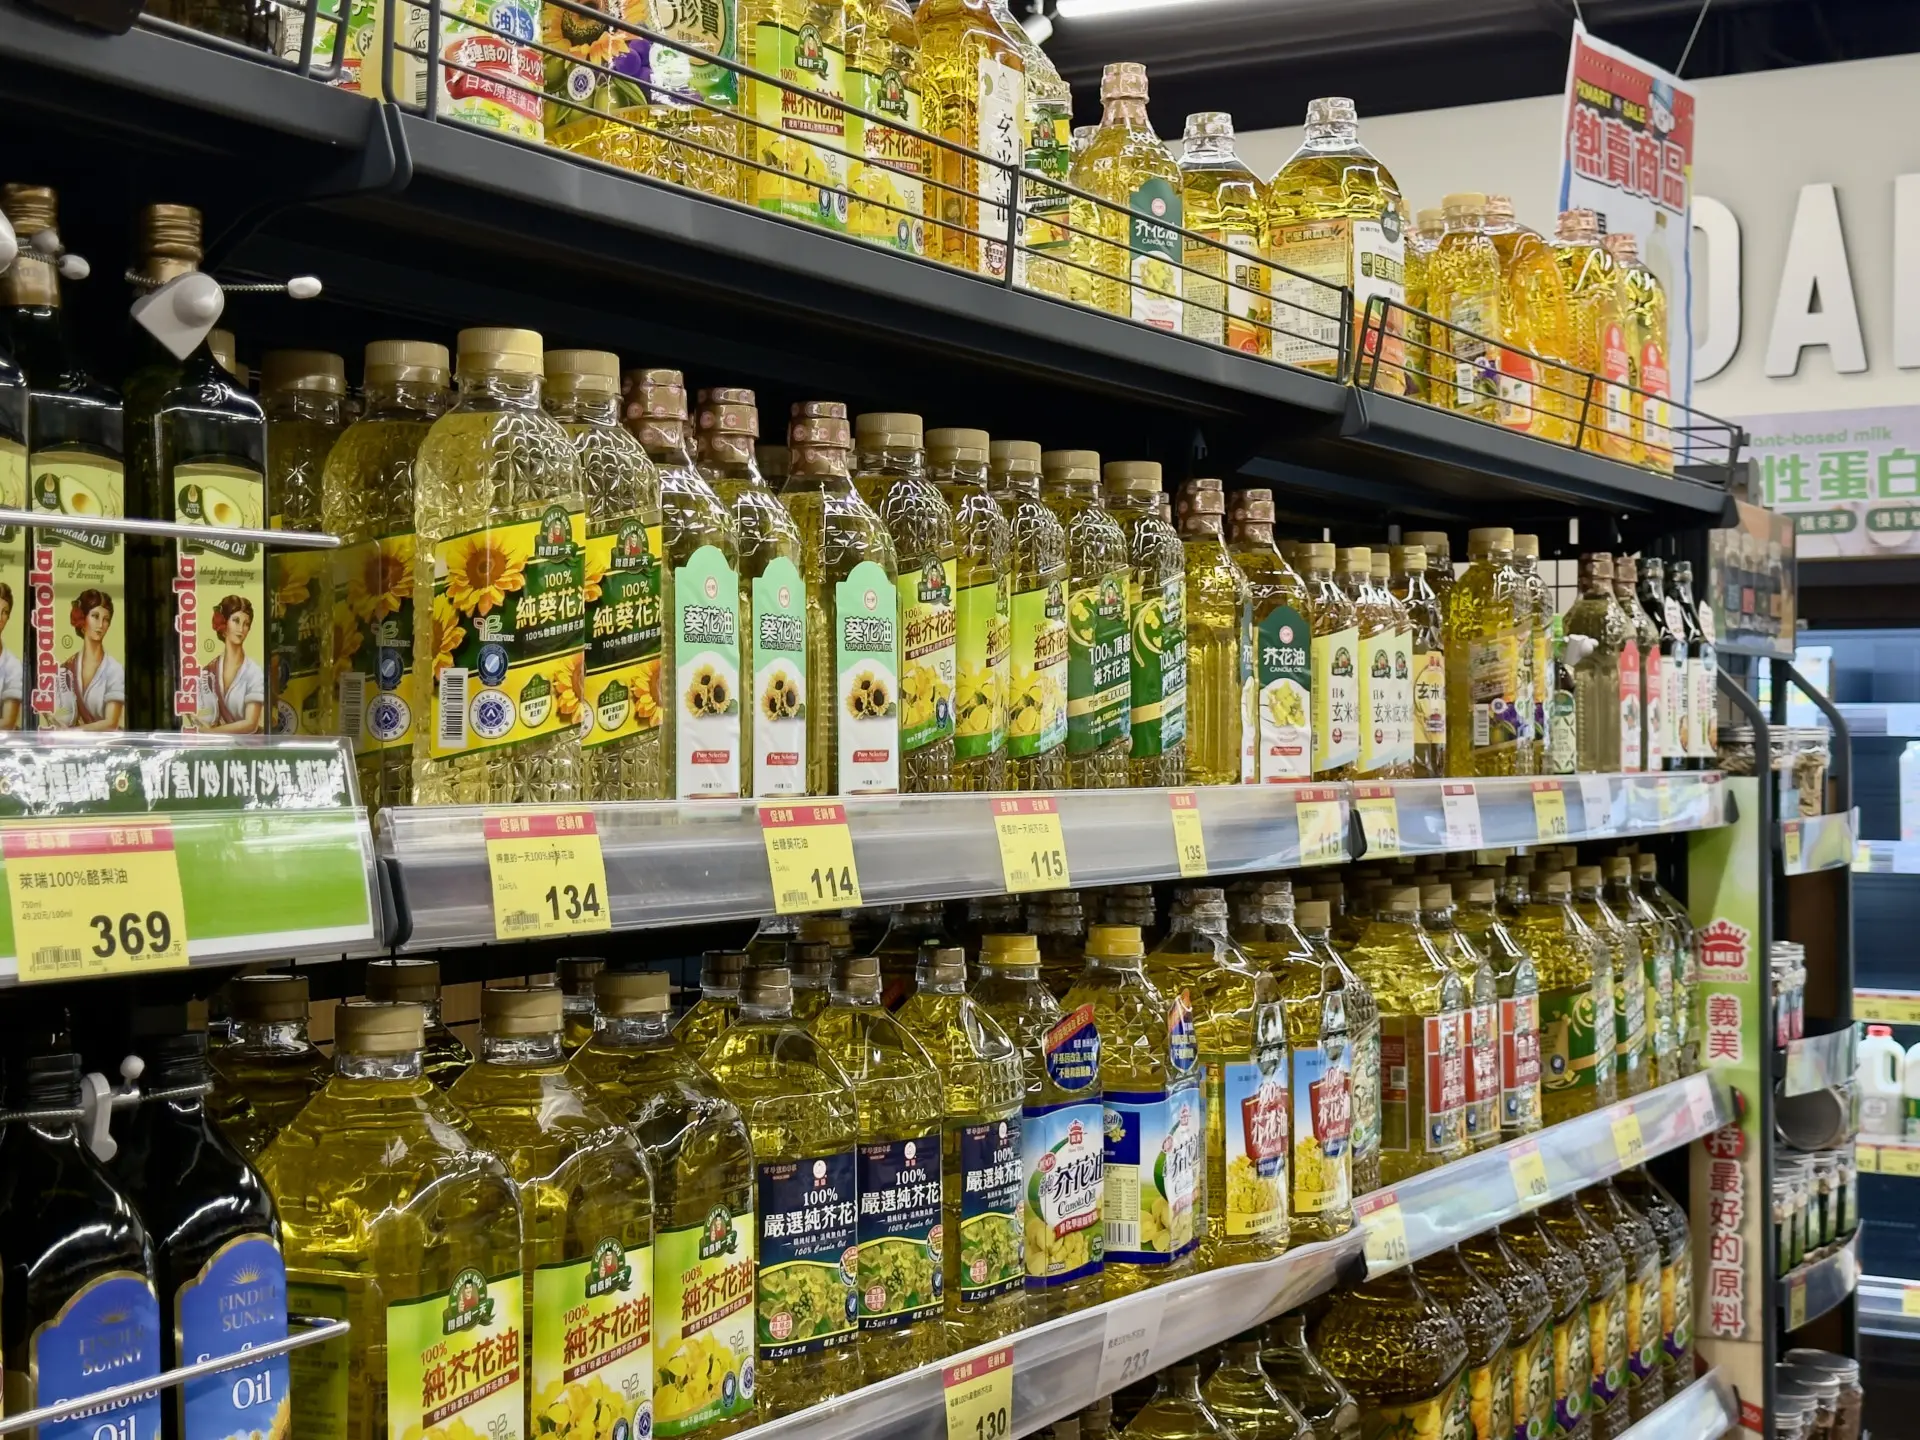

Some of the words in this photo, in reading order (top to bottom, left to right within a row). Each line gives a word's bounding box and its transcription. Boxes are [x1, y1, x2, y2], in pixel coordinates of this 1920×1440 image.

[780, 69, 797, 81] 100%
[466, 75, 537, 113] 日本原裝進口
[1622, 100, 1646, 124] SALE
[1576, 106, 1685, 213] 熱賣商品
[1748, 430, 1848, 447] lant-based
[1853, 426, 1892, 442] milk
[51, 527, 89, 543] vocado
[91, 534, 107, 549] Oil
[231, 542, 247, 556] Oil
[76, 571, 104, 582] dressing
[88, 561, 115, 574] cooking
[545, 570, 572, 588] 100%
[622, 580, 650, 598] 100%
[29, 545, 58, 713] Española
[684, 605, 734, 635] 葵花油
[760, 614, 803, 643] 葵花油
[844, 617, 893, 643] 葵花油
[172, 553, 201, 716] Española
[1263, 647, 1306, 667] 芥花油
[1332, 687, 1344, 699] 日本
[1373, 689, 1384, 700] 日本
[500, 817, 530, 833] 促銷價
[556, 815, 584, 830] 促銷價
[1184, 845, 1201, 861] 135
[1319, 832, 1339, 854] 115
[1031, 851, 1063, 877] 115
[19, 868, 128, 890] 萊瑞100%酪梨油
[811, 867, 853, 898] 114
[545, 883, 600, 920] 134
[90, 910, 172, 958] 369
[173, 940, 181, 952] 元
[1709, 996, 1739, 1060] 義美
[993, 1146, 1014, 1163] 100%
[896, 1168, 926, 1186] 100%
[803, 1186, 838, 1207] 100%
[861, 1181, 942, 1215] 嚴選純芥花
[1057, 1196, 1083, 1217] Canola
[707, 1208, 721, 1227] GREAT
[764, 1200, 858, 1238] 嚴選純芥花
[595, 1242, 612, 1262] GREAT
[1384, 1240, 1405, 1261] 215
[453, 1273, 472, 1296] GREAT
[681, 1264, 703, 1285] 100%
[219, 1286, 276, 1312] FINDER
[681, 1256, 753, 1321] 純芥花油
[222, 1306, 275, 1332] SUNNY
[563, 1303, 590, 1325] 100%
[80, 1325, 144, 1356] FINDER
[563, 1293, 650, 1365] 純芥花油
[82, 1350, 142, 1377] SUNNY
[421, 1341, 448, 1366] 100%
[1120, 1349, 1149, 1381] 233
[422, 1326, 519, 1408] 純芥花油
[231, 1369, 273, 1410] Oil
[92, 1415, 137, 1440] Oil
[976, 1407, 1006, 1440] 130
